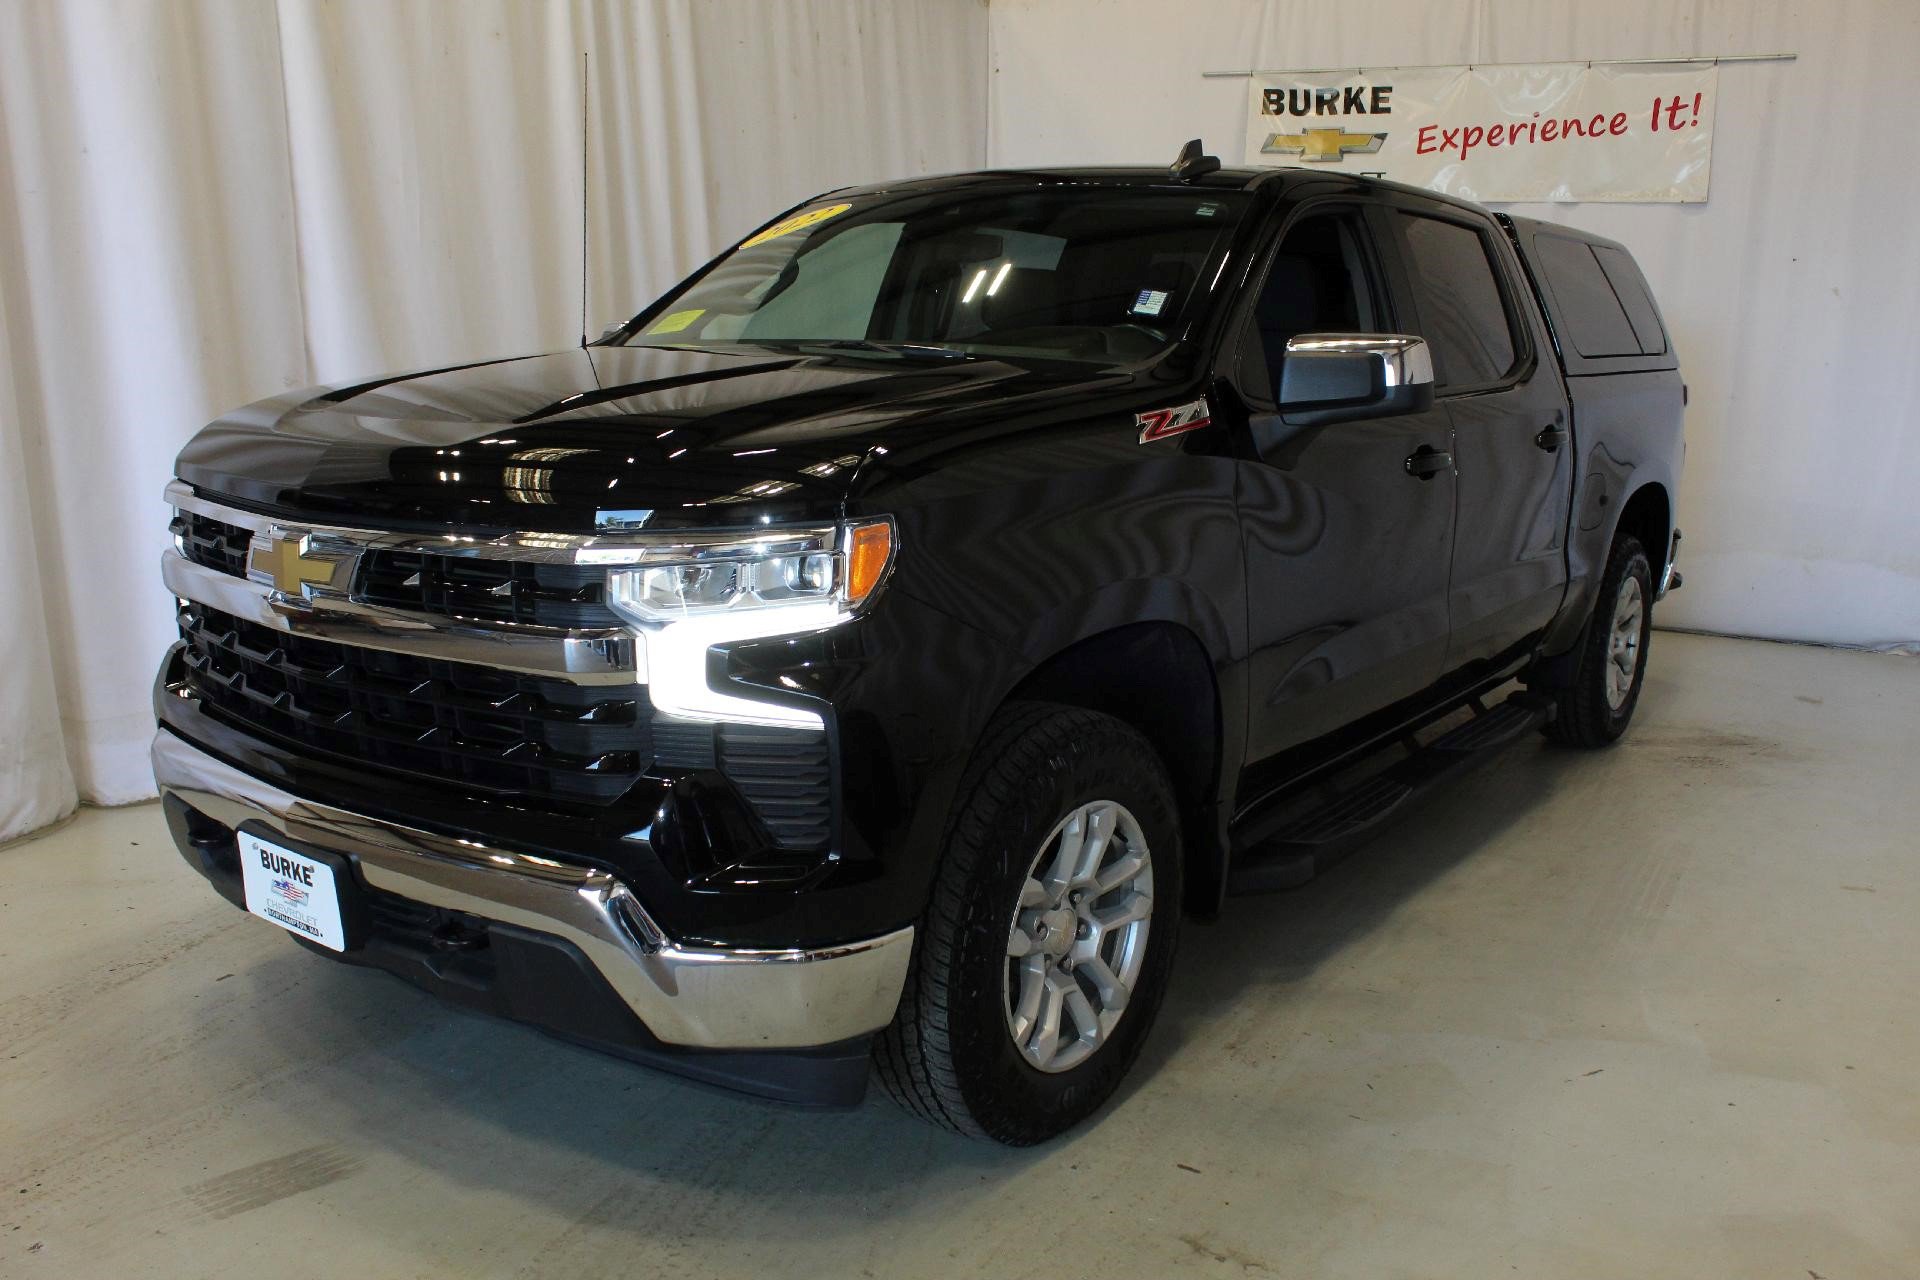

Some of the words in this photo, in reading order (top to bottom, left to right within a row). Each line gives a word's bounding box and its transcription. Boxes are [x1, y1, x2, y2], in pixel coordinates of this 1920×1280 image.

[1262, 86, 1393, 116] BURKE
[1416, 112, 1628, 160] Experience
[1651, 92, 1702, 132] It!
[260, 848, 313, 888] BURKE
[266, 898, 318, 926] CHEVROLET
